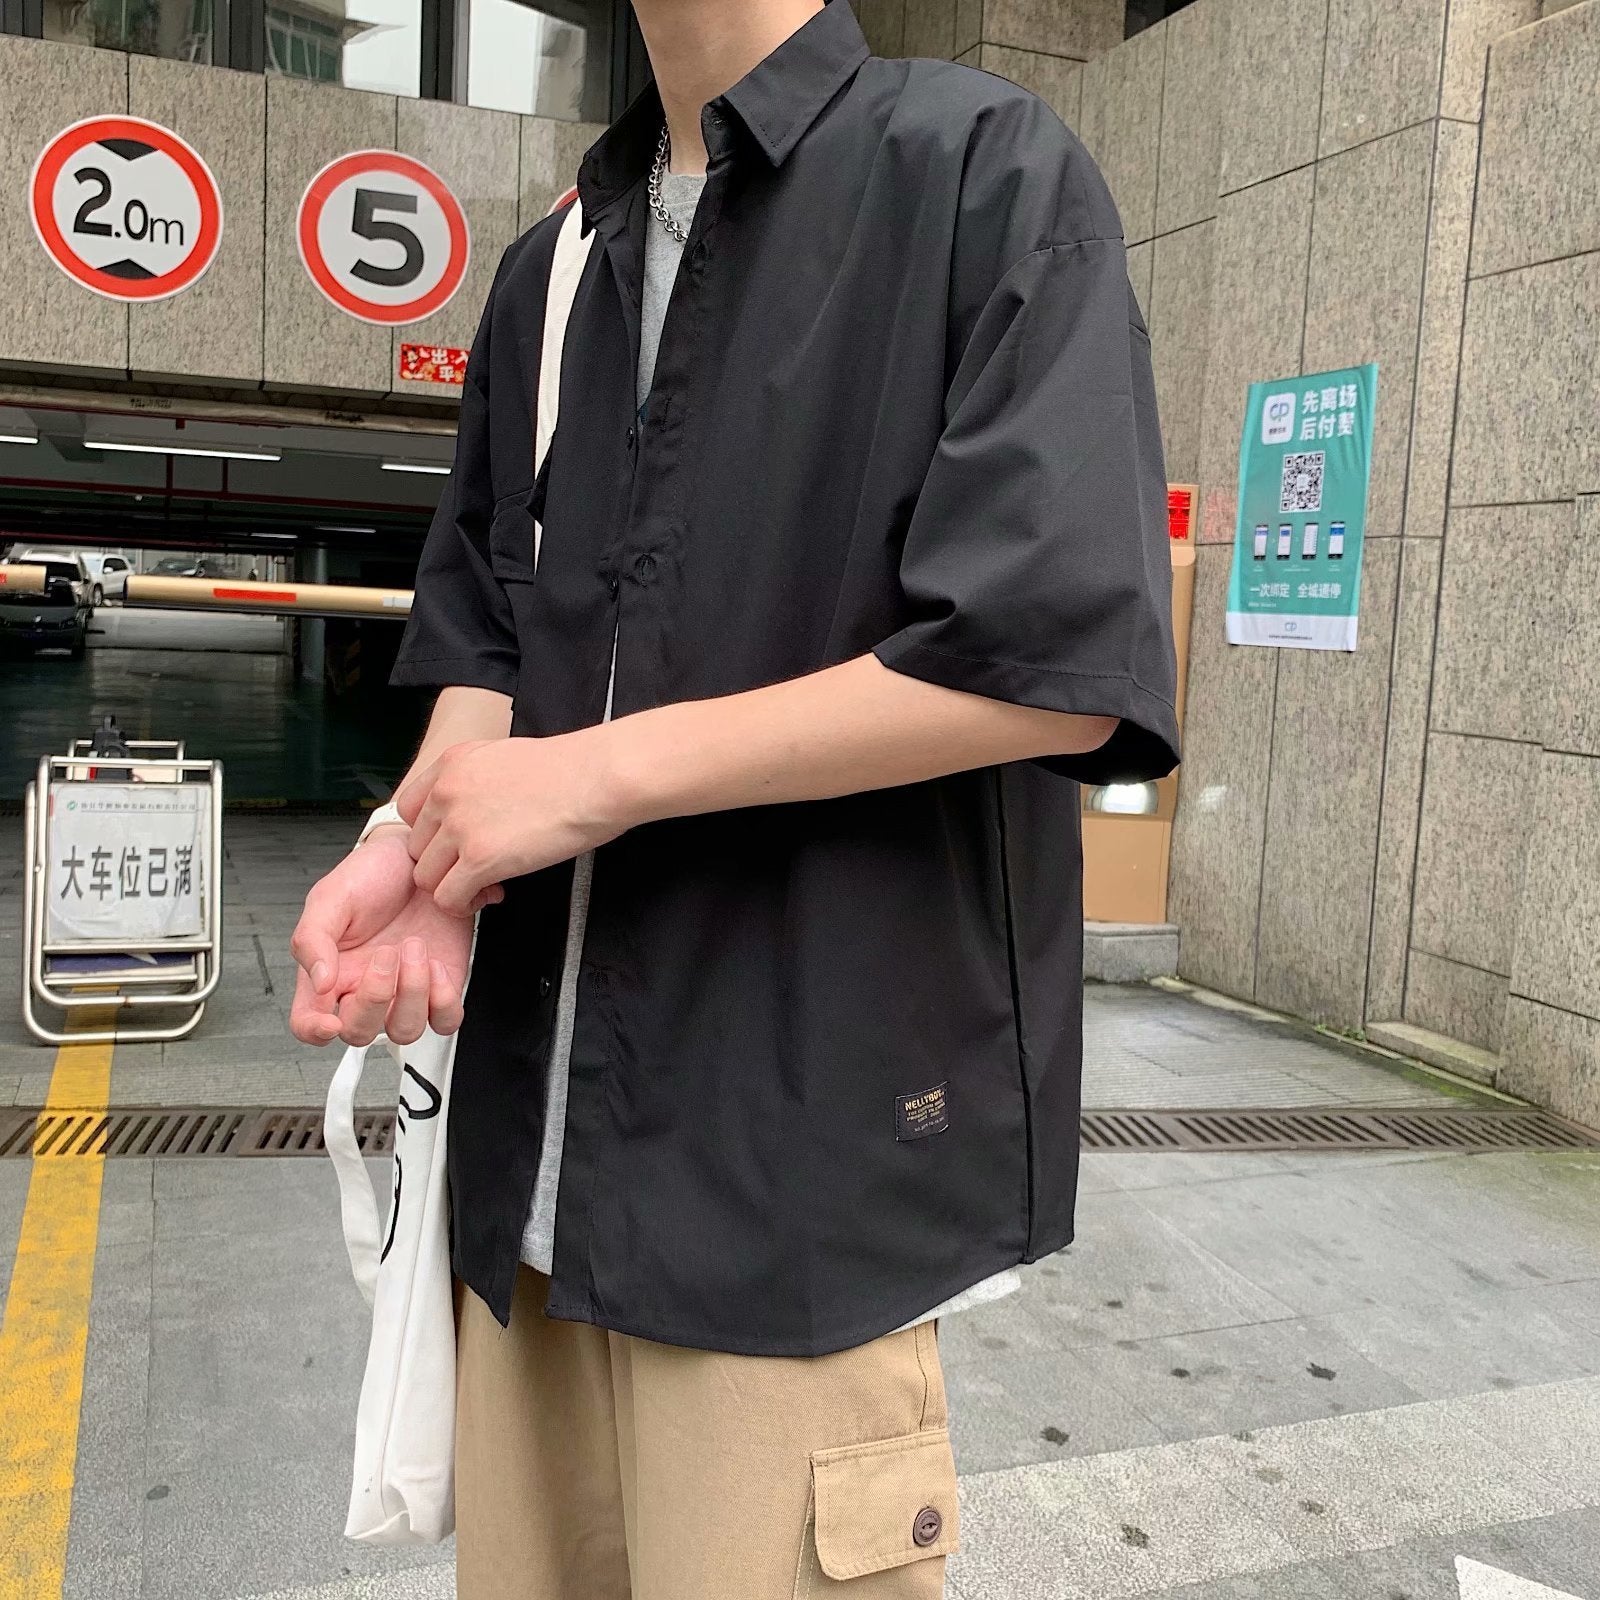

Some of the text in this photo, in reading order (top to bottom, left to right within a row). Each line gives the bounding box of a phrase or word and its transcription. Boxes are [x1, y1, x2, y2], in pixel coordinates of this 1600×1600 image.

[73, 167, 184, 246] 2.0m
[350, 188, 425, 287] 5
[1300, 411, 1355, 441] 后付费
[1302, 384, 1358, 415] 先离场
[60, 844, 193, 901] 大车位已满
